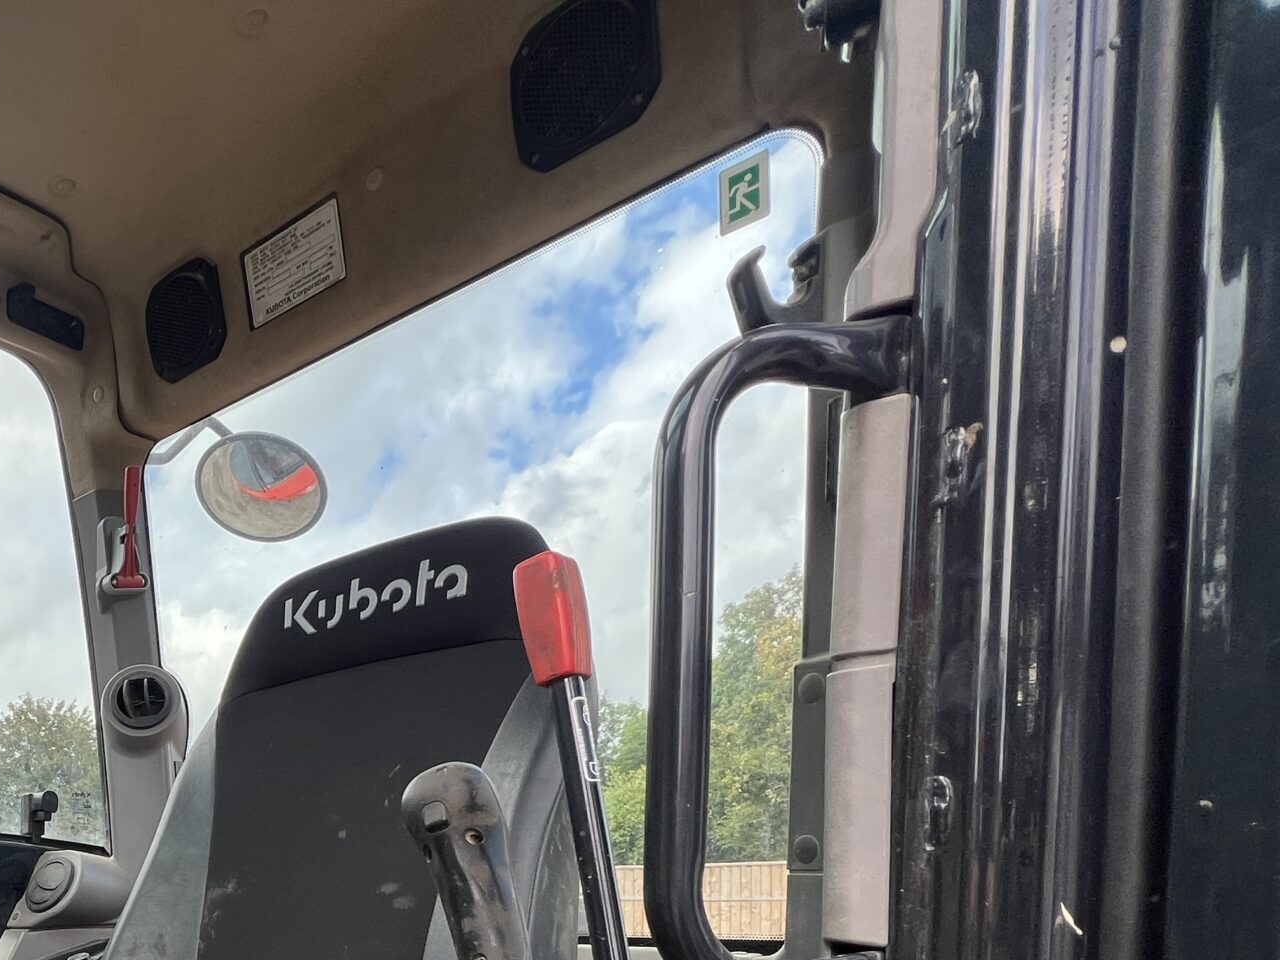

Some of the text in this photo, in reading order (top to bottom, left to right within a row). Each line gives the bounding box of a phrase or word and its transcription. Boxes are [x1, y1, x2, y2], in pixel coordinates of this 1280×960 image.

[266, 275, 330, 315] KUBOTA Corporation
[283, 559, 468, 635] Kubota
